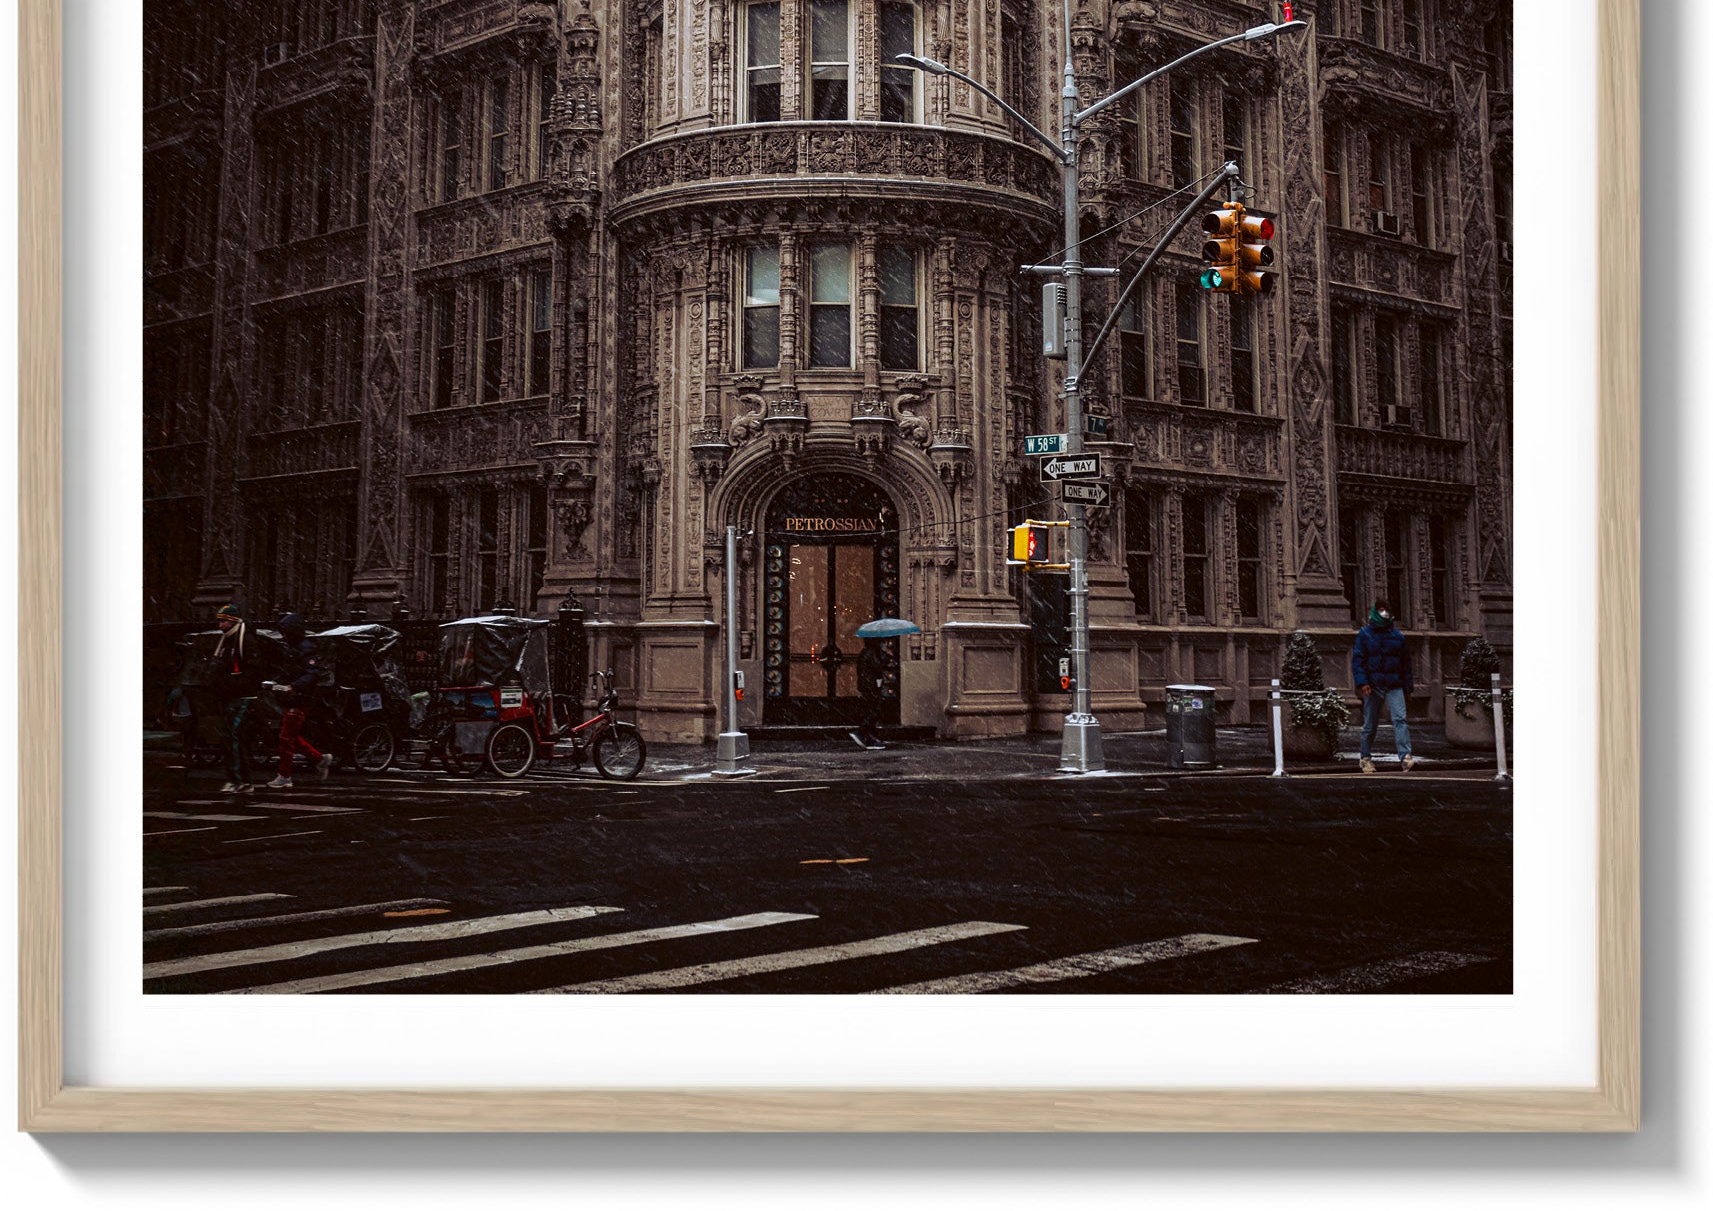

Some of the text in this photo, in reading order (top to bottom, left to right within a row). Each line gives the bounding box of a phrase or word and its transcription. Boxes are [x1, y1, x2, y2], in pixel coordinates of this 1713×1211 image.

[1027, 436, 1058, 452] W 58 ST
[1049, 461, 1092, 474] ONE WAY
[1068, 486, 1103, 499] ONE WAY
[785, 517, 876, 531] PETROSSIAN
